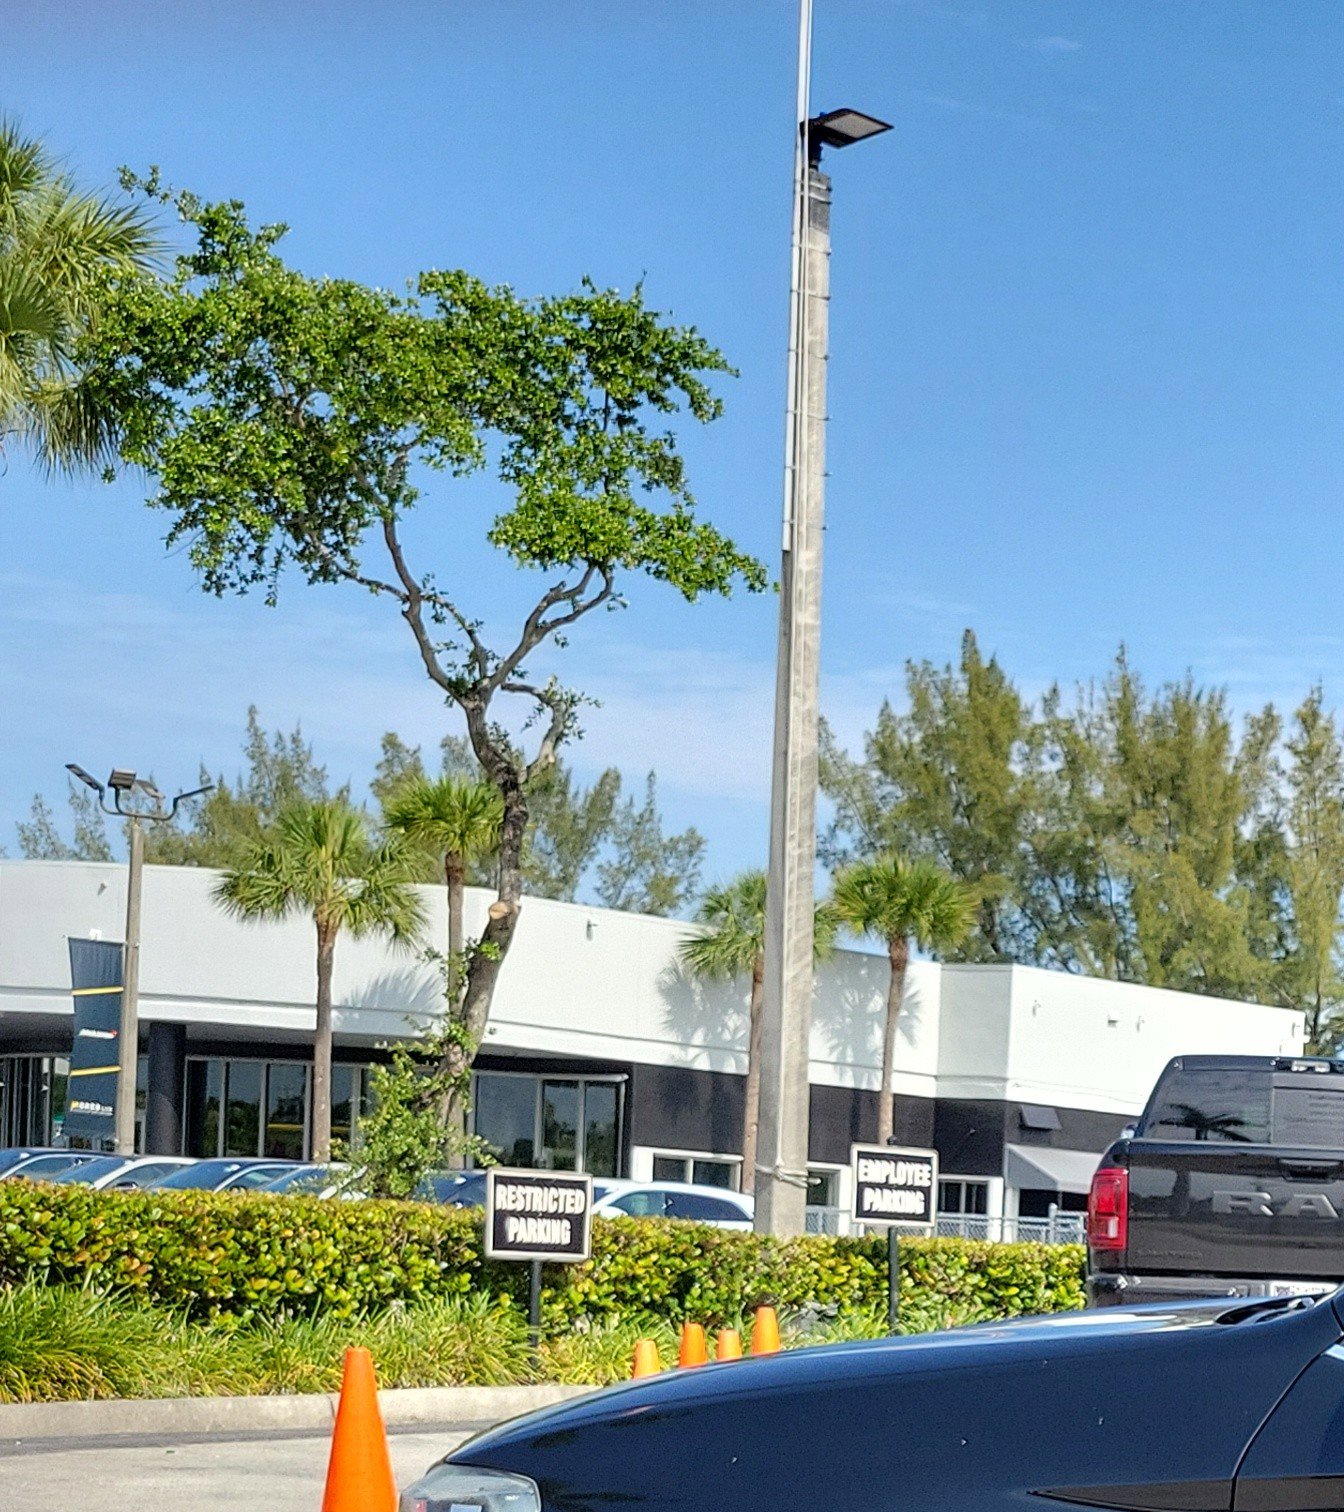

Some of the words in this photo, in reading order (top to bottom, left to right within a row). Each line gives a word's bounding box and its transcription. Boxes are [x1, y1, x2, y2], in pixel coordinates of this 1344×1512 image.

[858, 1158, 932, 1187] EMPLOYEE
[495, 1183, 586, 1215] RESTRICTED
[863, 1187, 925, 1215] PARKING
[505, 1216, 571, 1245] PARKING
